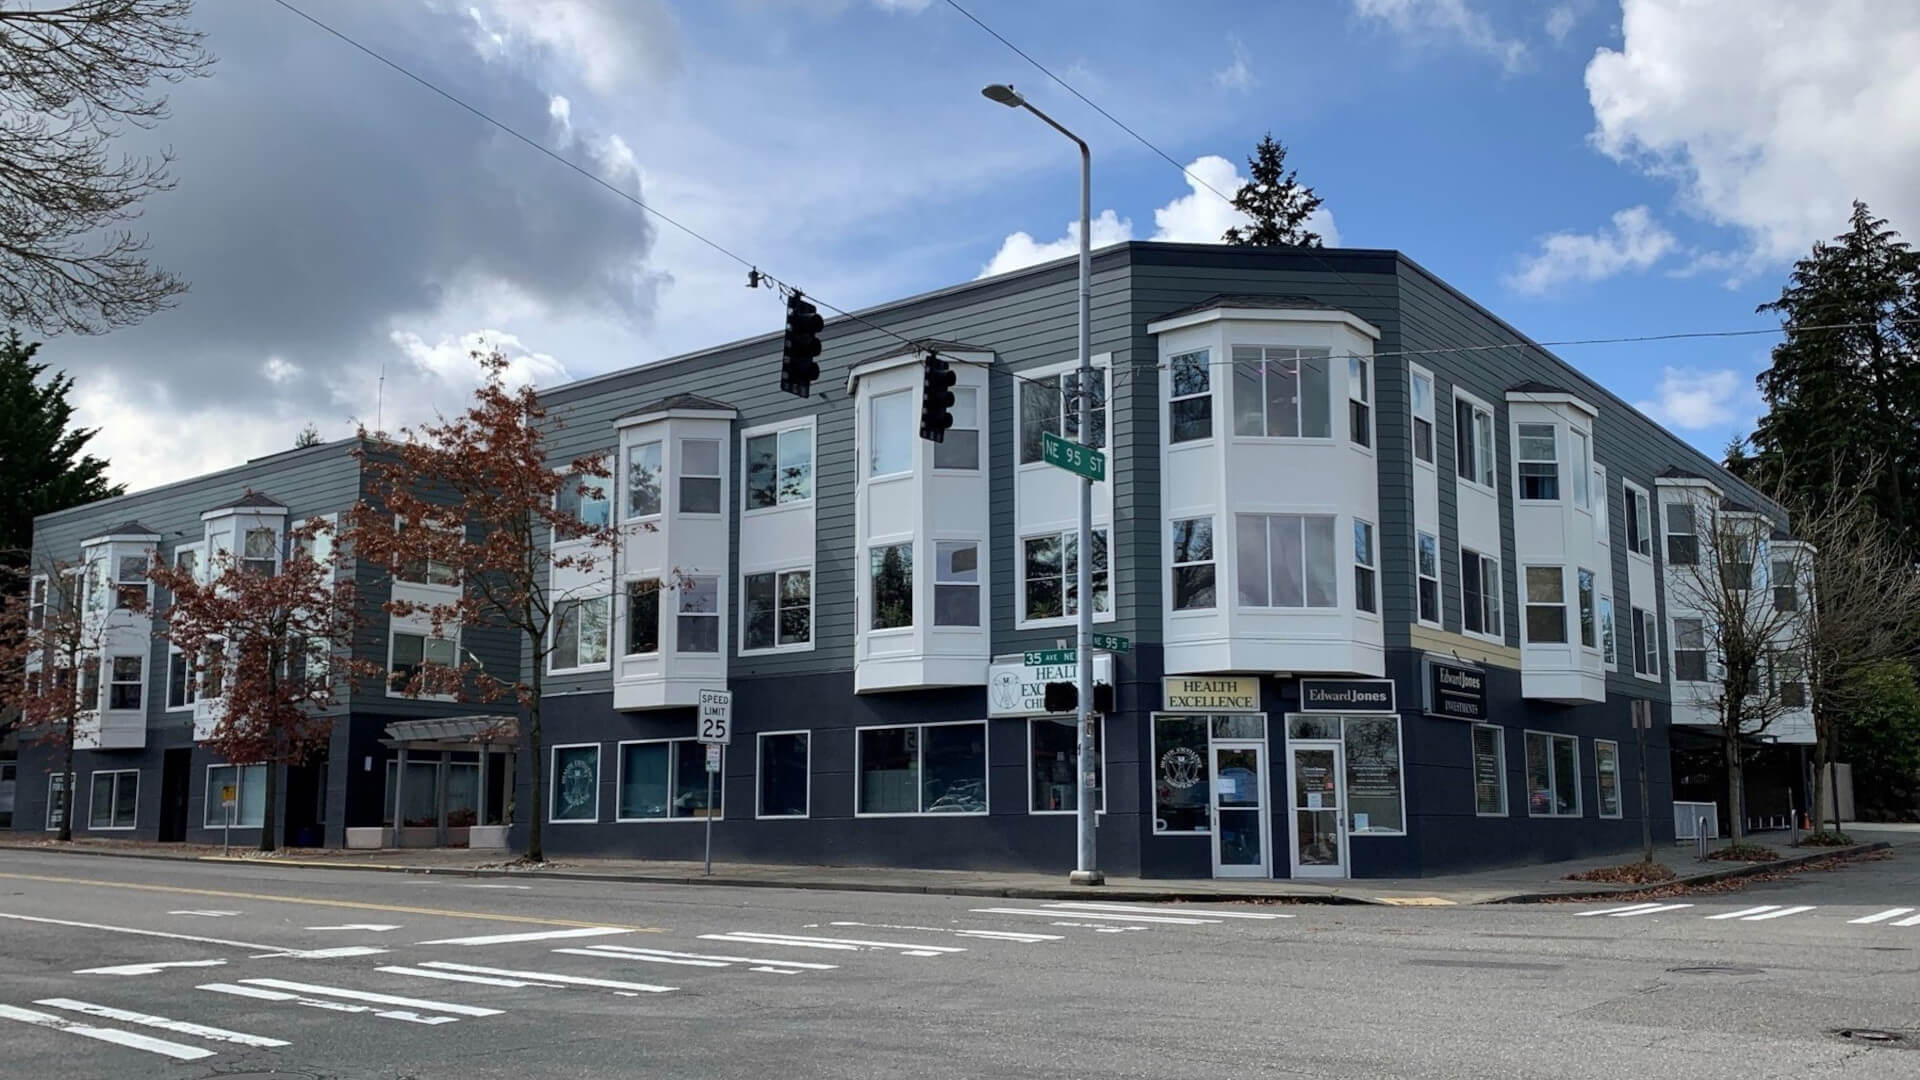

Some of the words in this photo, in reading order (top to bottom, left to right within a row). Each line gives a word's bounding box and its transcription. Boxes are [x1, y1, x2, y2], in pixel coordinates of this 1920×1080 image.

[1046, 439, 1060, 459] NE
[1066, 447, 1082, 467] 95
[1089, 456, 1103, 473] ST
[1105, 636, 1118, 650] 95
[1026, 652, 1042, 665] 35
[1045, 654, 1058, 662] AVE
[1063, 651, 1075, 661] NE
[1036, 665, 1078, 680] HEALT
[1183, 681, 1238, 693] HEALTH
[702, 694, 729, 705] SPEED
[1169, 696, 1253, 708] EXCELLENCE
[704, 706, 726, 717] LIMIT
[703, 719, 726, 738] 25
